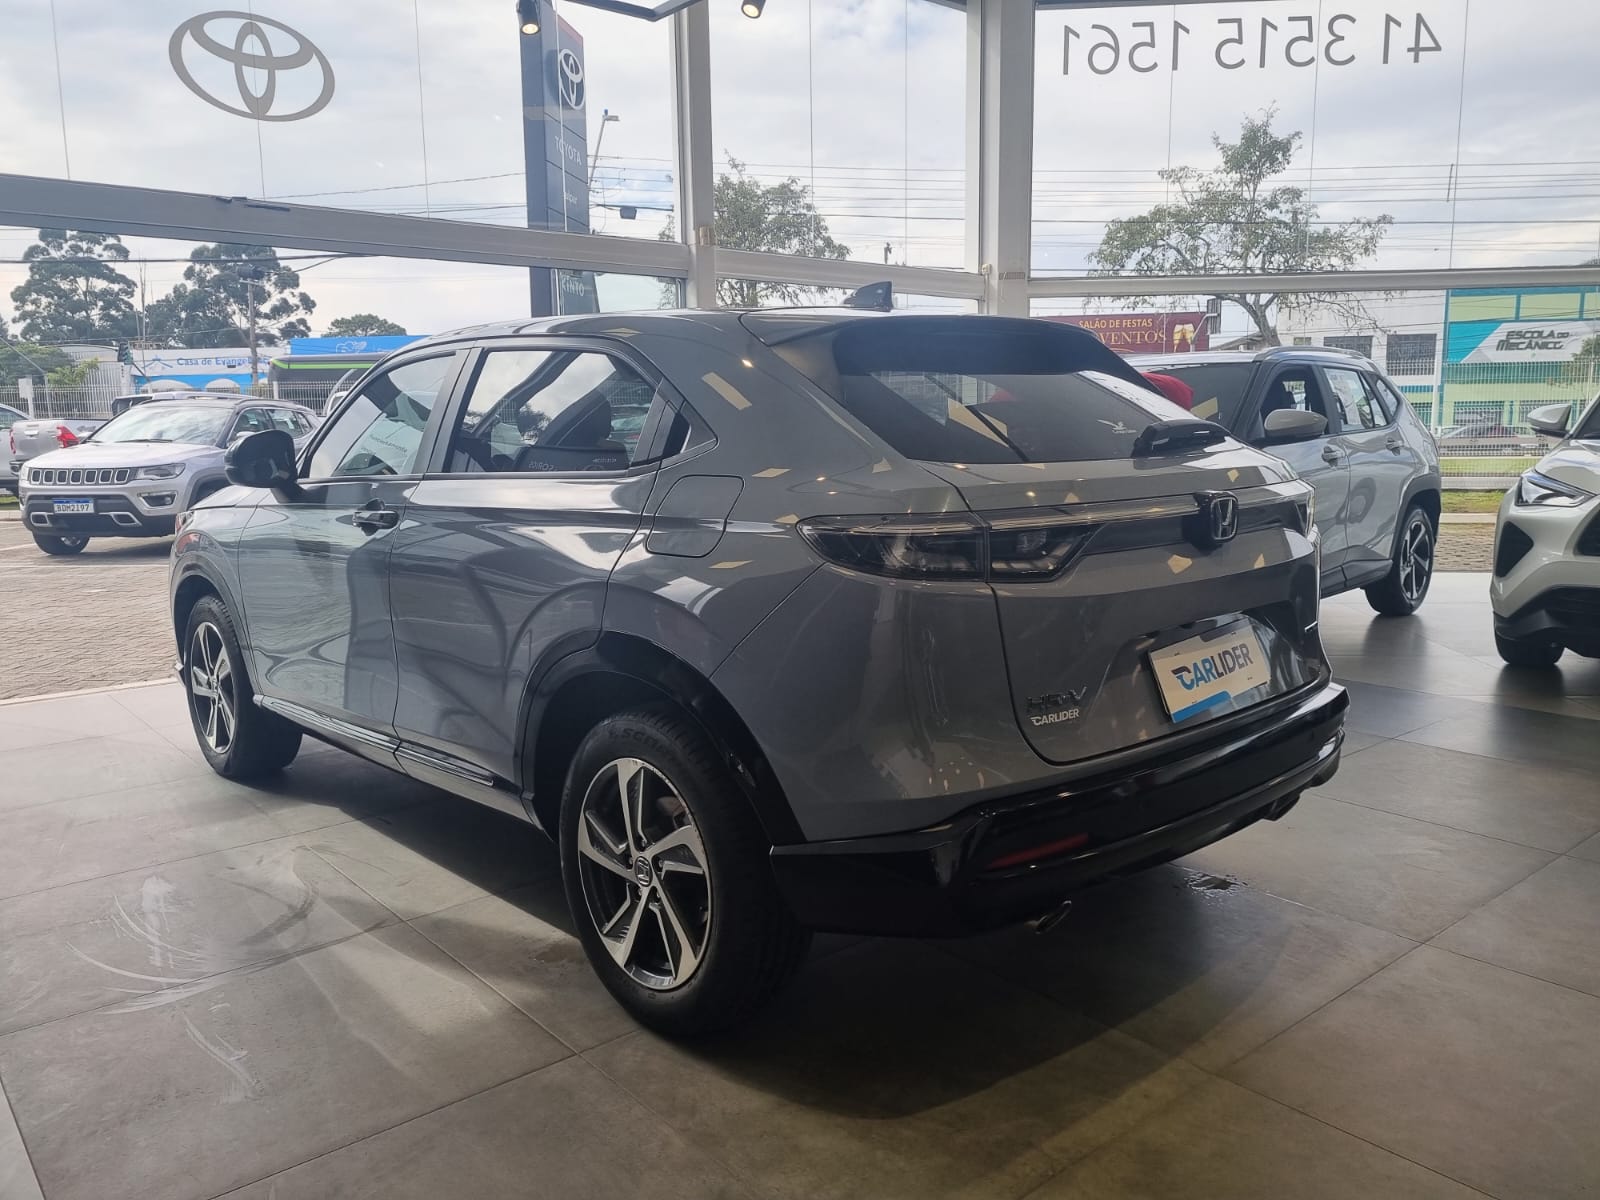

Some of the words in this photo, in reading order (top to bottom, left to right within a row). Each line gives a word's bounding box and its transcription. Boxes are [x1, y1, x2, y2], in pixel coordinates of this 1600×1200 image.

[554, 135, 582, 167] TOYOTA
[1078, 318, 1107, 329] SALÃO
[1109, 319, 1120, 328] DE
[1122, 318, 1153, 328] FESTAS
[1097, 329, 1167, 345] VENTOS
[1506, 330, 1555, 339] ESCOLA
[176, 358, 199, 366] Casa
[201, 358, 212, 366] de
[1171, 643, 1253, 690] CARLIDER
[1030, 708, 1080, 726] CARLIDER
